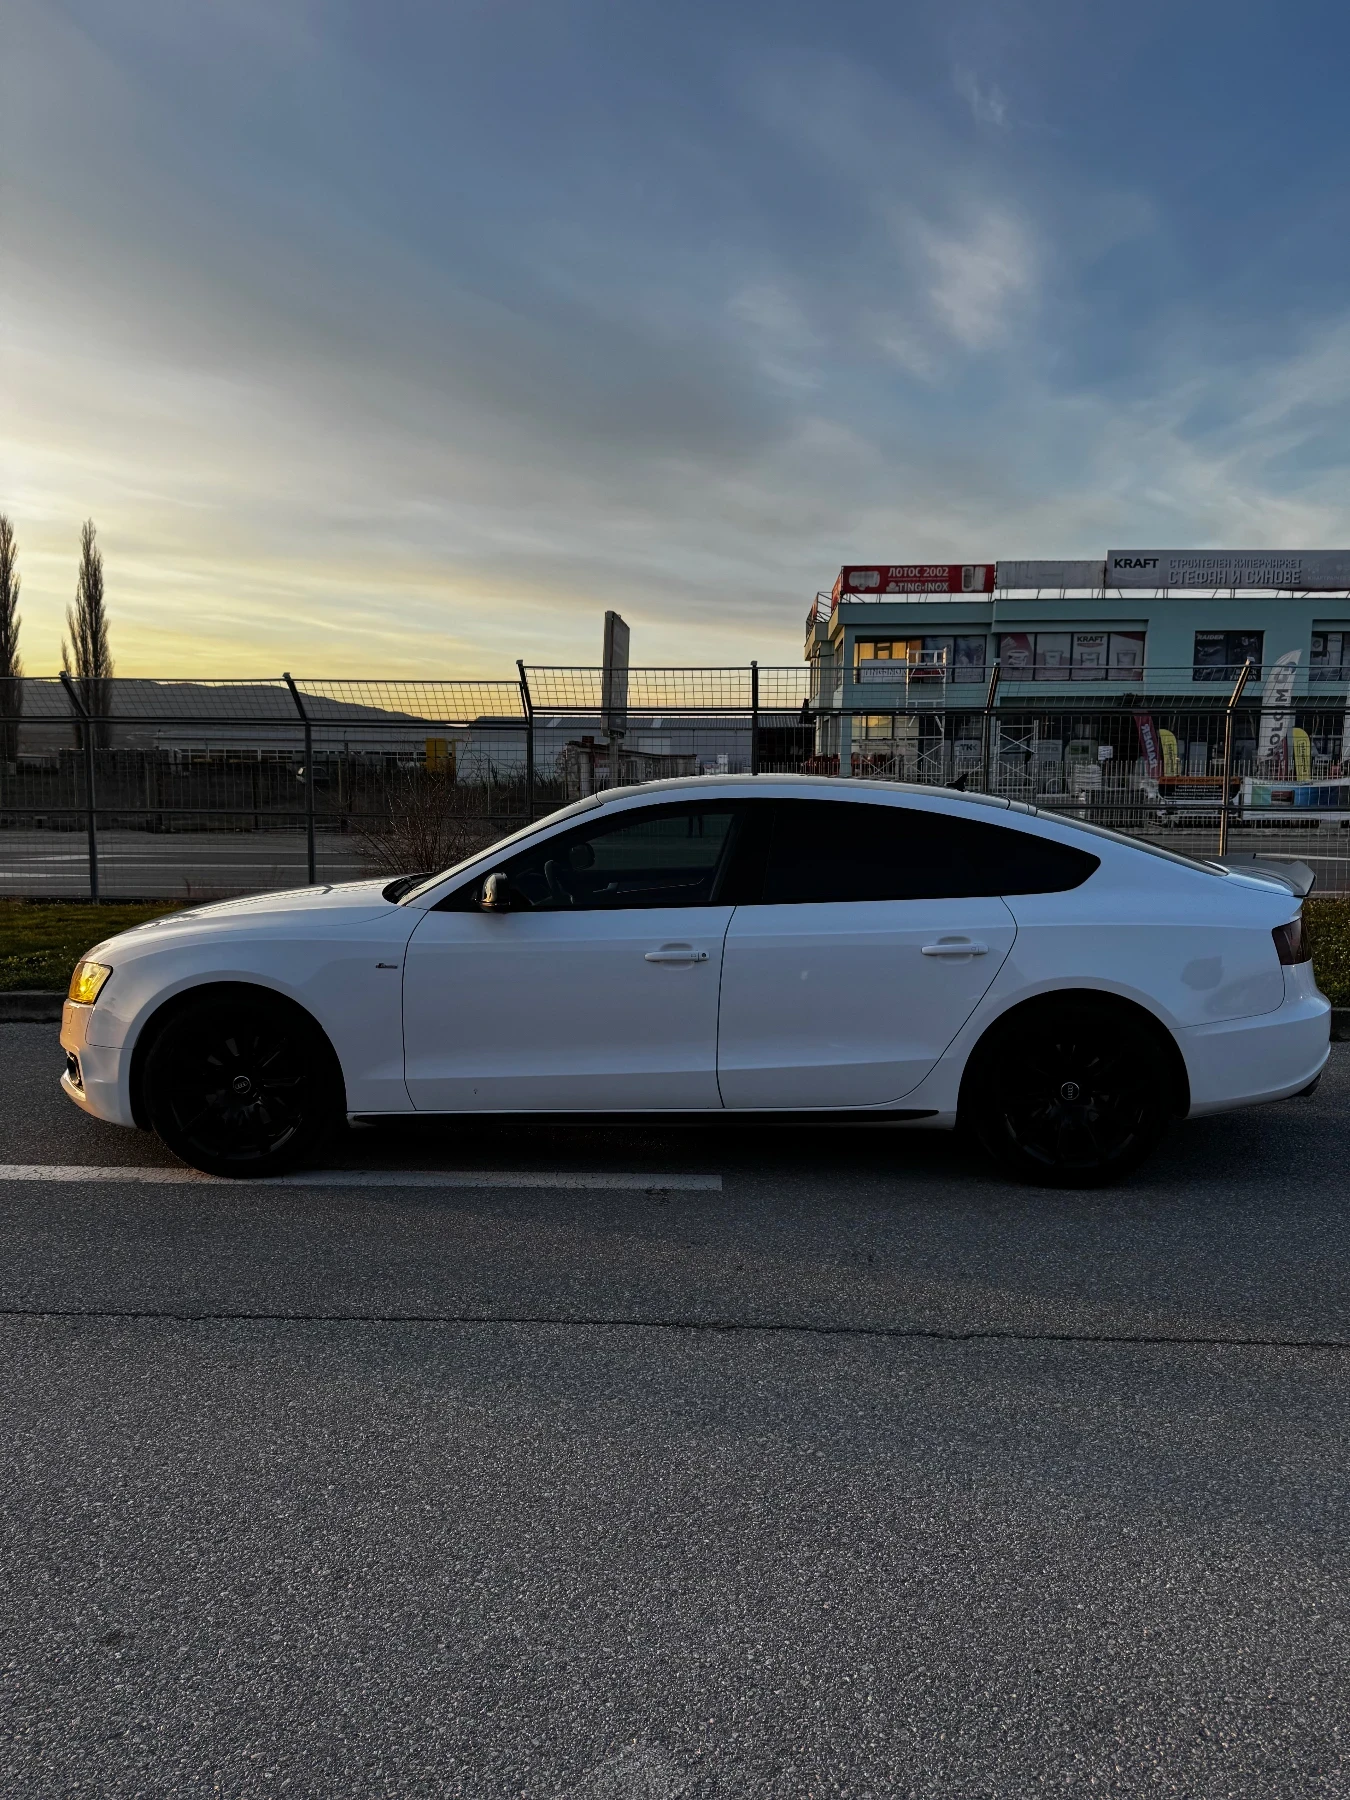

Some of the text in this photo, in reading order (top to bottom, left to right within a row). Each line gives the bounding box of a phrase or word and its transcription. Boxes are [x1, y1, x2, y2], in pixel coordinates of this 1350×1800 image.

[1114, 558, 1159, 568] KRAFT
[1169, 559, 1231, 569] СТРОИТЕЛЕН
[888, 567, 949, 577] ЛОТОС 2002
[1168, 570, 1302, 584] СТЕФАН И СИНОВЕ
